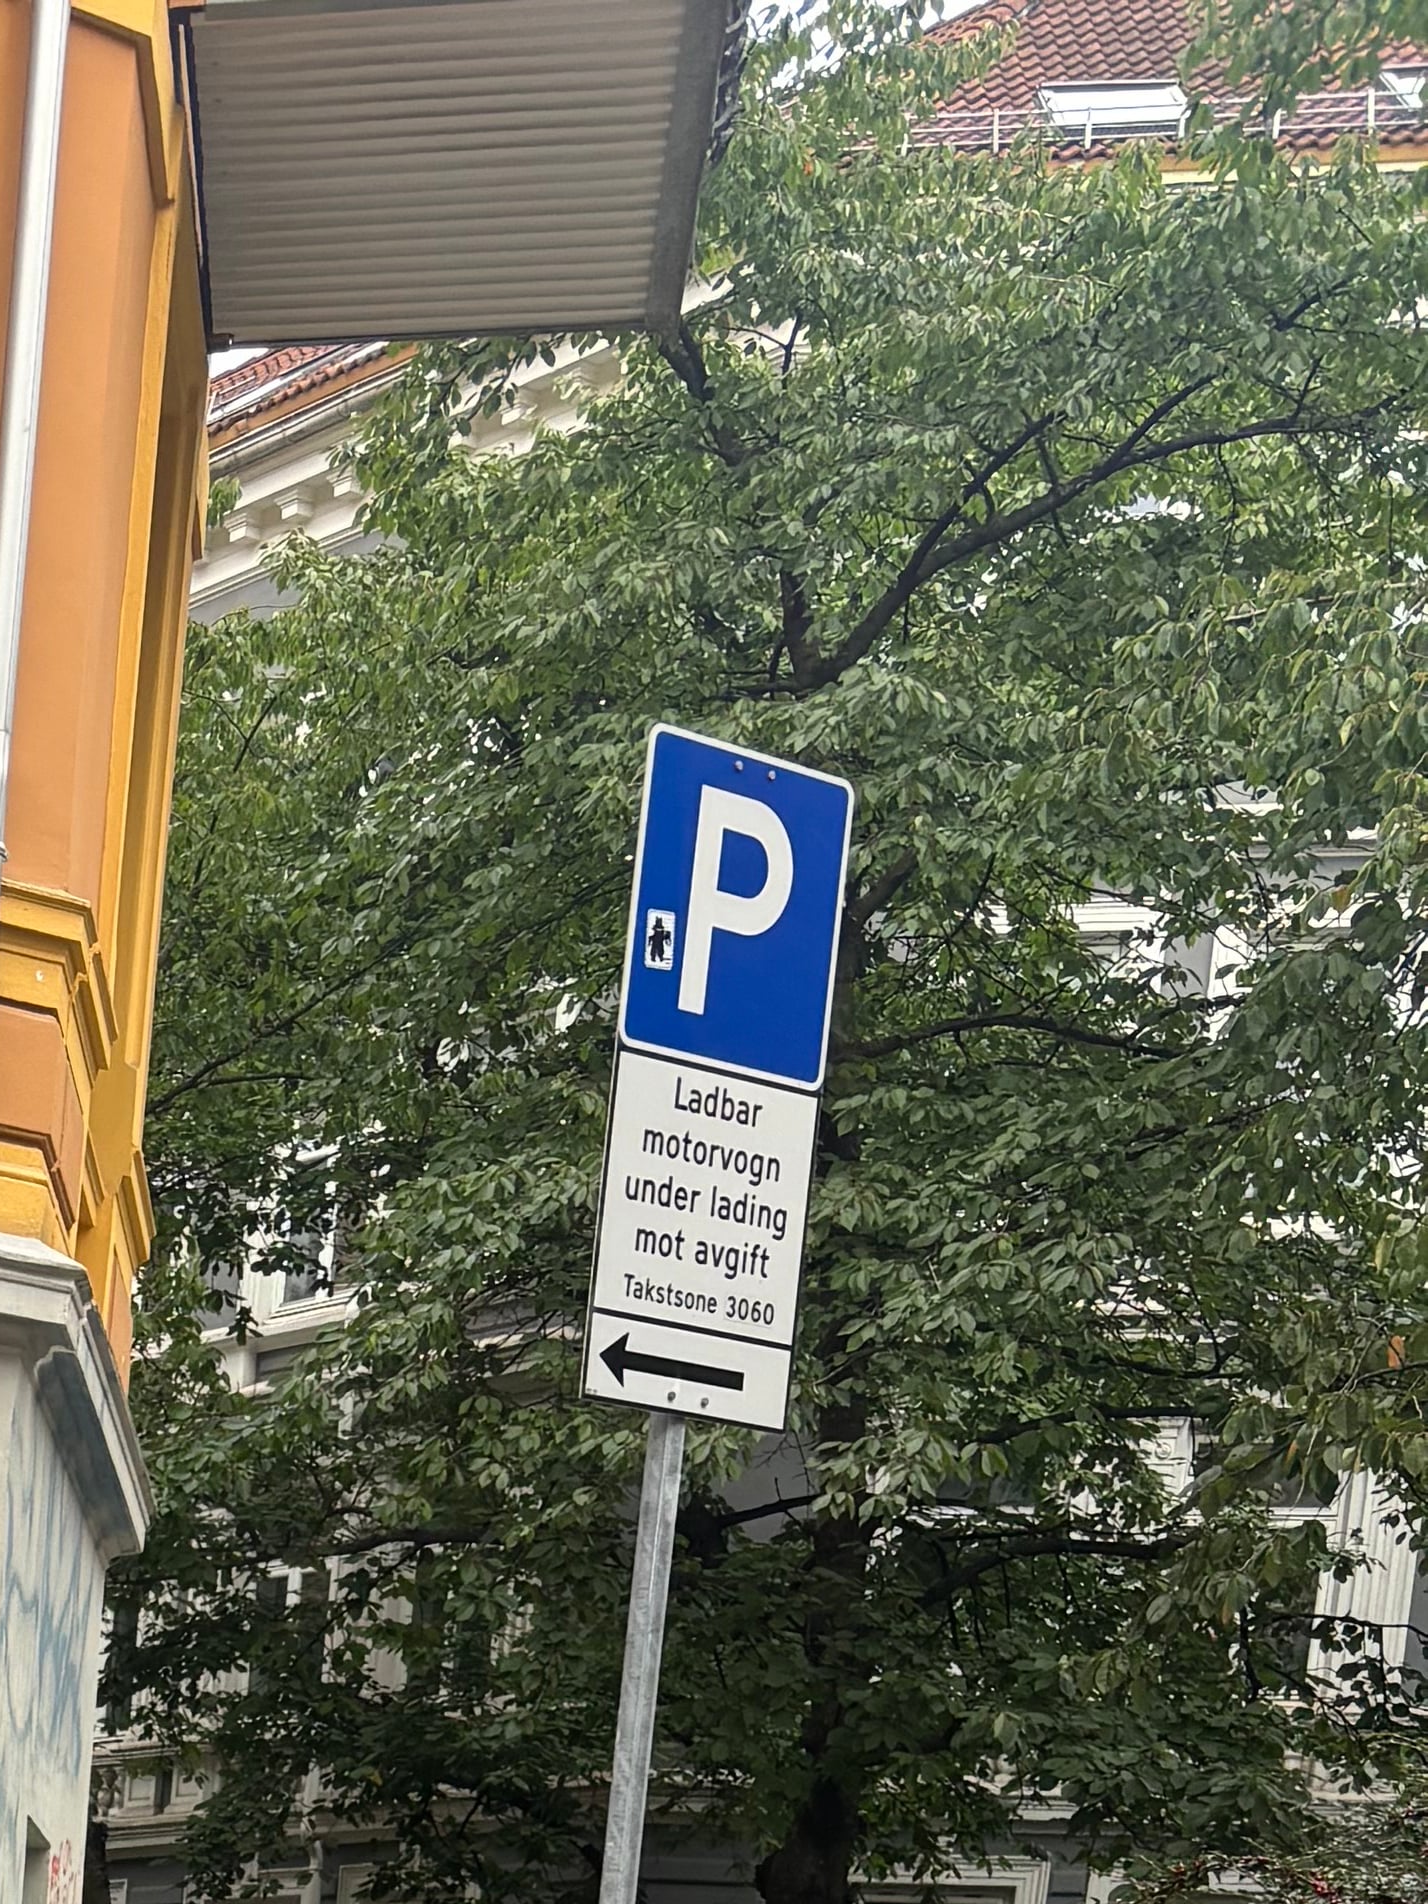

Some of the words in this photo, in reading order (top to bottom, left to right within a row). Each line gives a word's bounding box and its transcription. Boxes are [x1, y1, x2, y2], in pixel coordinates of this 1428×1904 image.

[677, 783, 795, 1016] P
[673, 1076, 763, 1129] Ladbar
[642, 1129, 782, 1186] motorvogn
[624, 1175, 701, 1216] under
[709, 1186, 788, 1242] lading
[634, 1228, 685, 1262] mot
[694, 1233, 770, 1283] avgift
[623, 1272, 718, 1315] Takstsone
[724, 1294, 775, 1327] 3060
